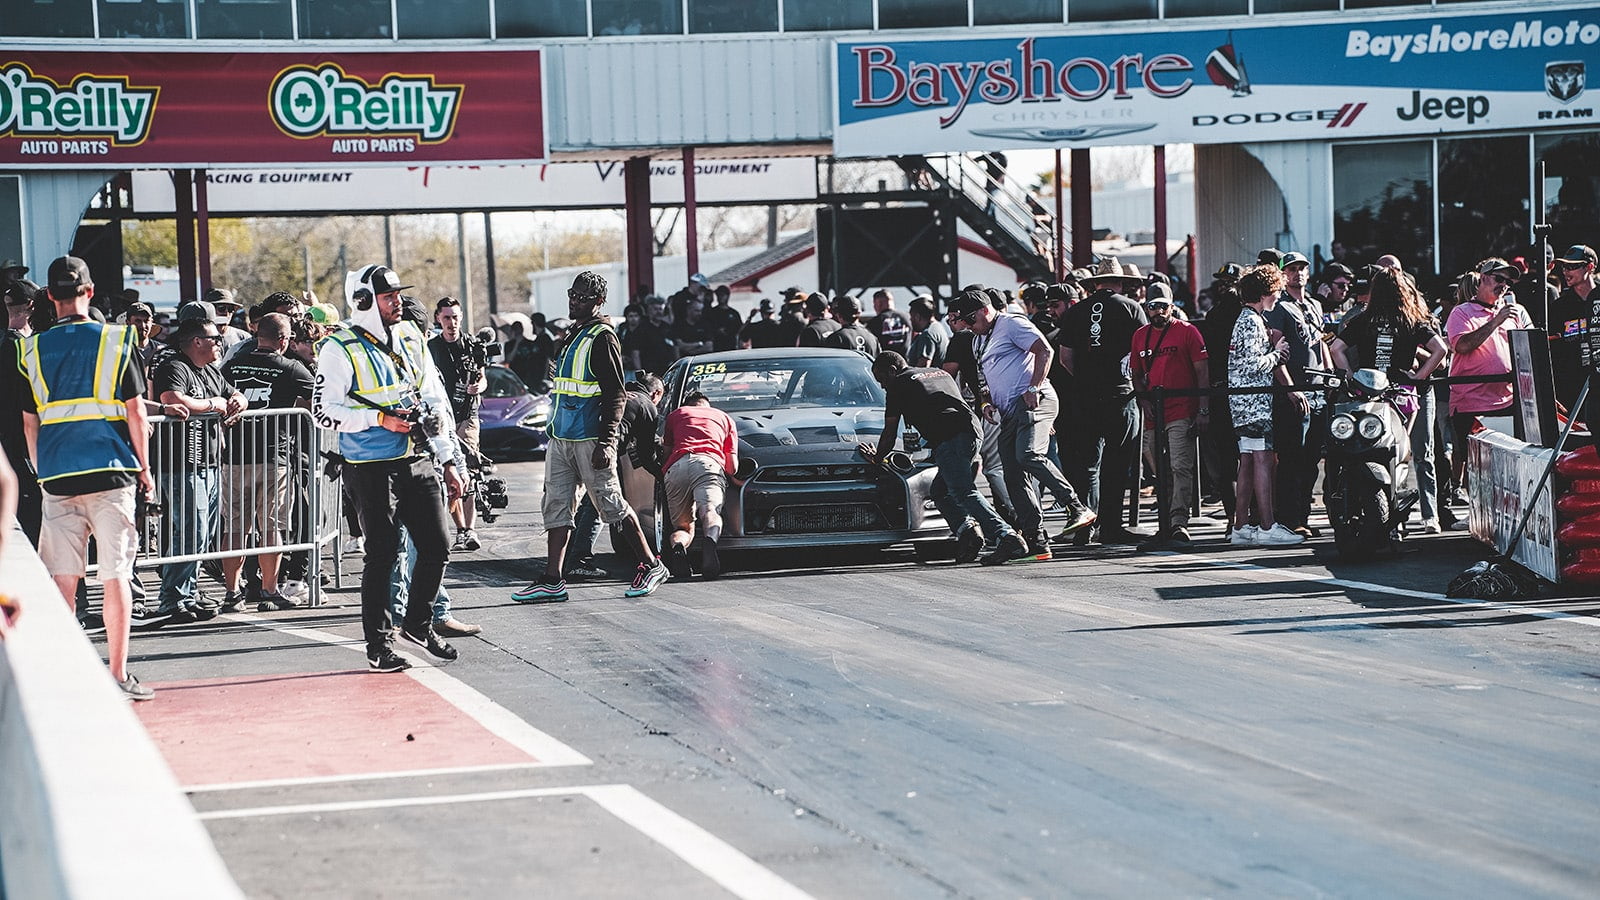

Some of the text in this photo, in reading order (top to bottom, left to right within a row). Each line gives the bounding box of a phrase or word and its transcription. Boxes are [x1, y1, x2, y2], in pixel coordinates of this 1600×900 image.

[1345, 20, 1600, 62] BayshoreMoto
[852, 37, 1194, 129] Bayshore
[0, 73, 146, 136] 'Reilly
[281, 73, 449, 134] O'Reilly
[1397, 90, 1490, 124] Jeep
[992, 107, 1135, 123] CHRYSLER
[1192, 109, 1339, 127] DODGE
[1537, 108, 1593, 120] RAM
[20, 140, 108, 154] AUTO PARTS
[332, 138, 415, 153] AUTO PARTS
[203, 172, 353, 184] ACING EQUIPMENT
[693, 363, 727, 376] 354
